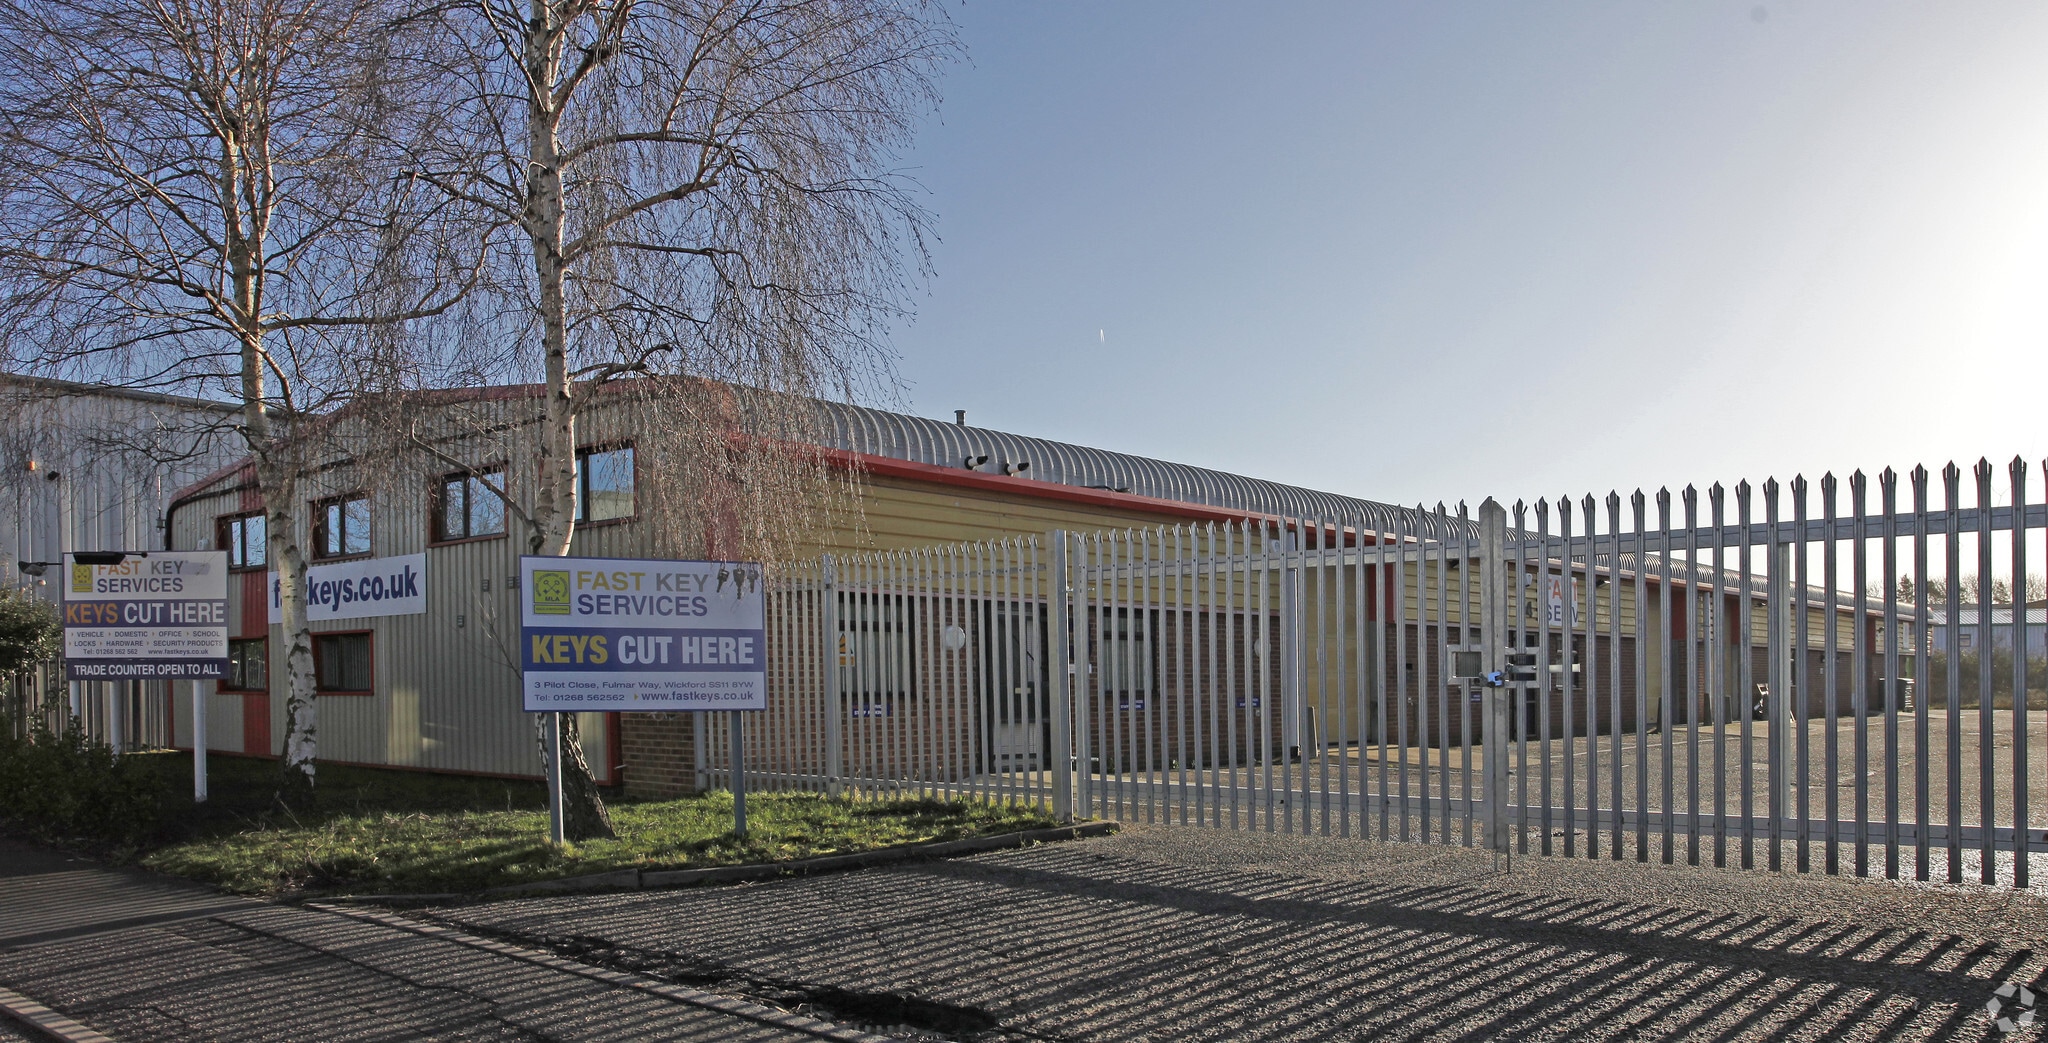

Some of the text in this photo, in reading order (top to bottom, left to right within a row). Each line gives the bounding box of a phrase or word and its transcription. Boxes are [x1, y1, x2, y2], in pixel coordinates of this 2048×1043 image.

[97, 560, 184, 575] FAST KEY
[97, 578, 184, 593] SERVICES
[273, 564, 419, 612] fkeys.co.uk
[576, 570, 646, 591] FAST
[655, 573, 709, 592] KEY
[577, 593, 708, 617] SERVICES
[66, 602, 225, 624] KEYS CUT HERE
[148, 648, 209, 656] www.fastkeys.co.uk
[531, 634, 755, 665] KEYS CUT HERE
[74, 663, 221, 676] TRADE COUNTER OPEN TO ALL
[534, 681, 541, 689] 3
[544, 681, 566, 689] Pilot
[568, 681, 599, 690] Close,
[602, 681, 635, 689] Fulmar
[664, 681, 706, 689] Wickford
[641, 691, 754, 703] www.fastkeys.co.uk
